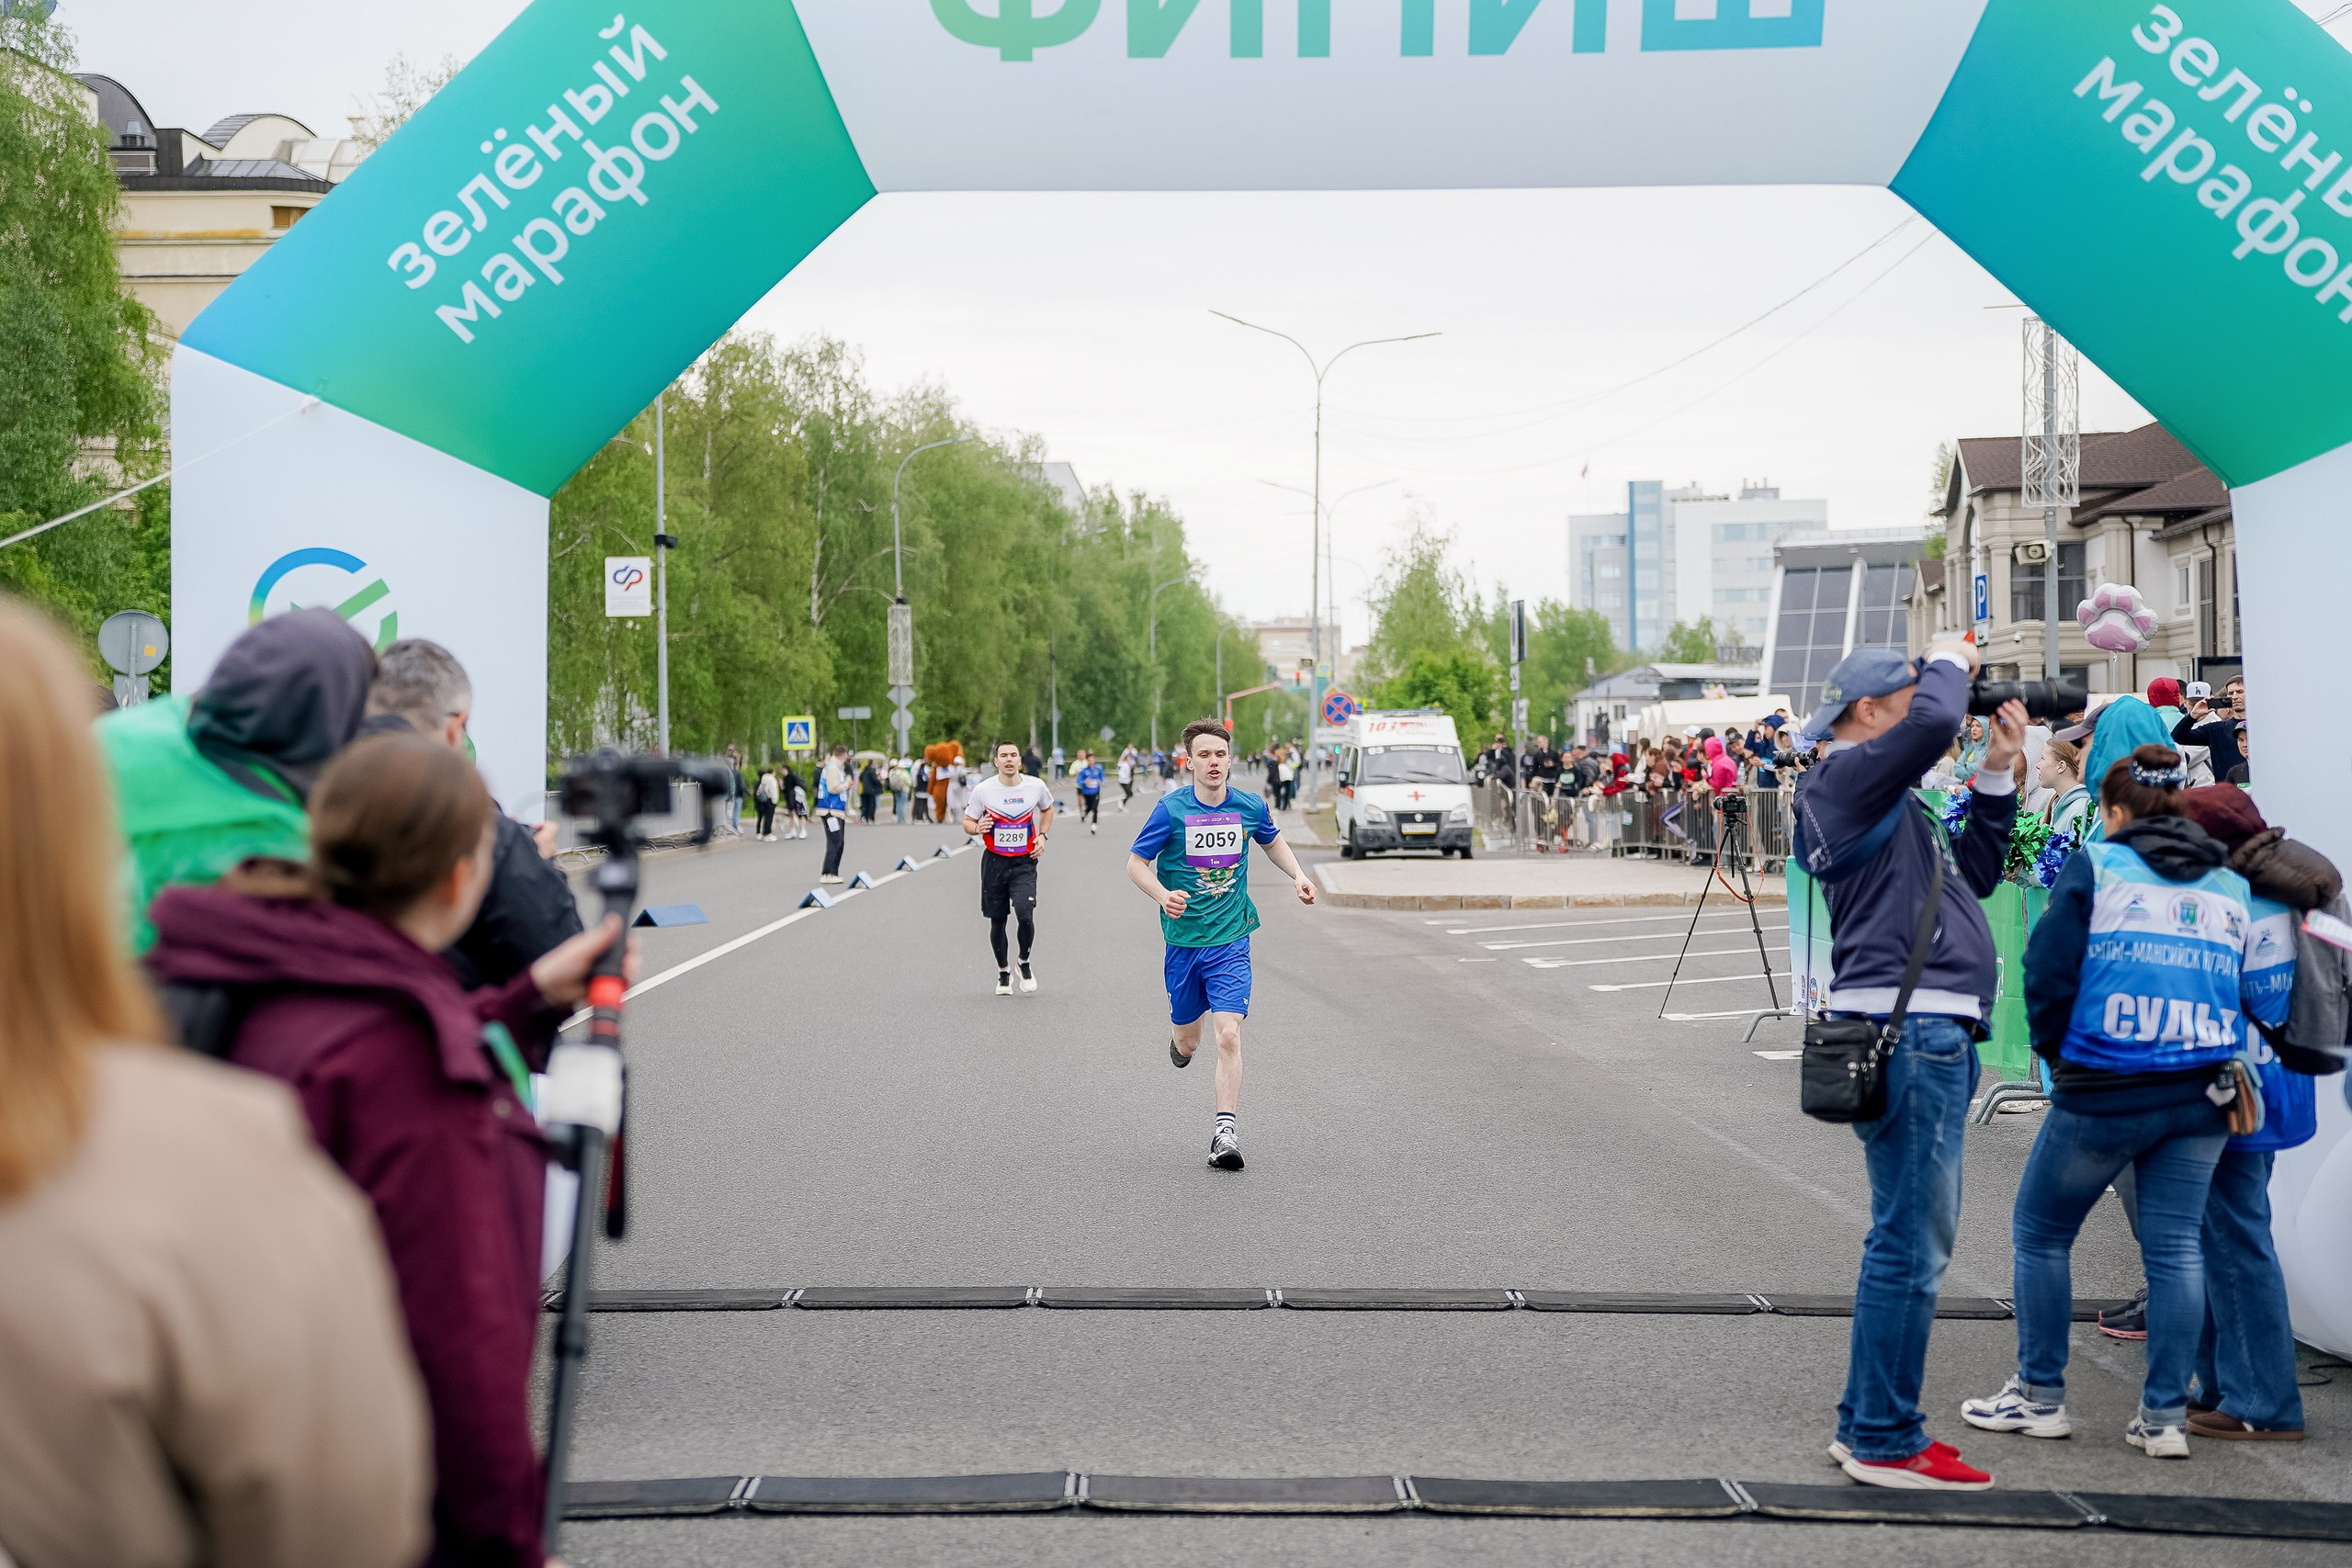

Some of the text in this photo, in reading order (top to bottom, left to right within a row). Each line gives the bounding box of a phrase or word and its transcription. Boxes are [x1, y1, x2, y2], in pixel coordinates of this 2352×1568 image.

[387, 13, 668, 289] зелёный
[435, 74, 719, 344] марафон
[1976, 579, 1986, 617] P
[999, 832, 1024, 842] 2289
[1194, 831, 1237, 849] 2059
